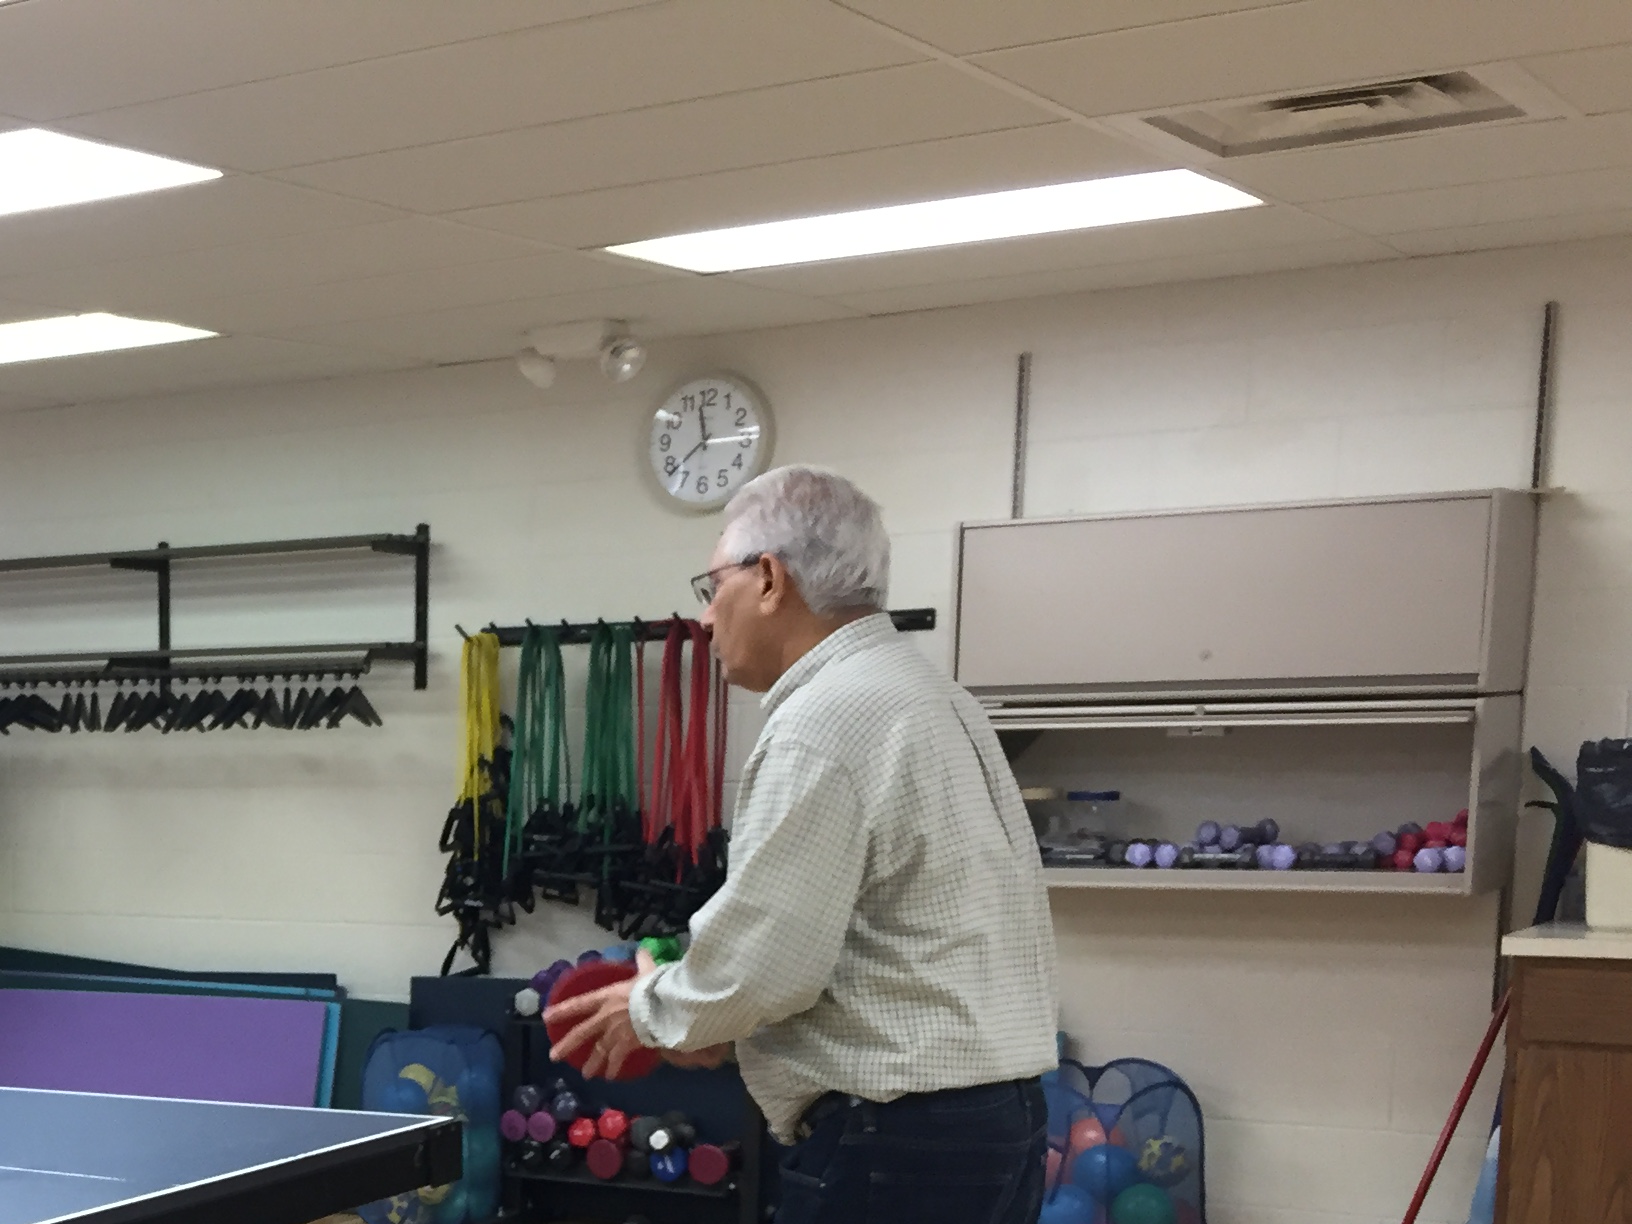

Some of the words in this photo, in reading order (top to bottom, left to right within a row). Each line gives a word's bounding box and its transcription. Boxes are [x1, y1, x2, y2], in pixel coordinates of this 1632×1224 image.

[680, 395, 695, 412] 11
[699, 388, 718, 406] 12
[723, 392, 732, 410] 1
[734, 407, 747, 427] 2
[659, 433, 672, 452] 9
[663, 455, 677, 475] 8
[731, 452, 743, 470] 4
[680, 470, 690, 488] 7
[696, 475, 709, 494] 6
[716, 469, 729, 488] 5
